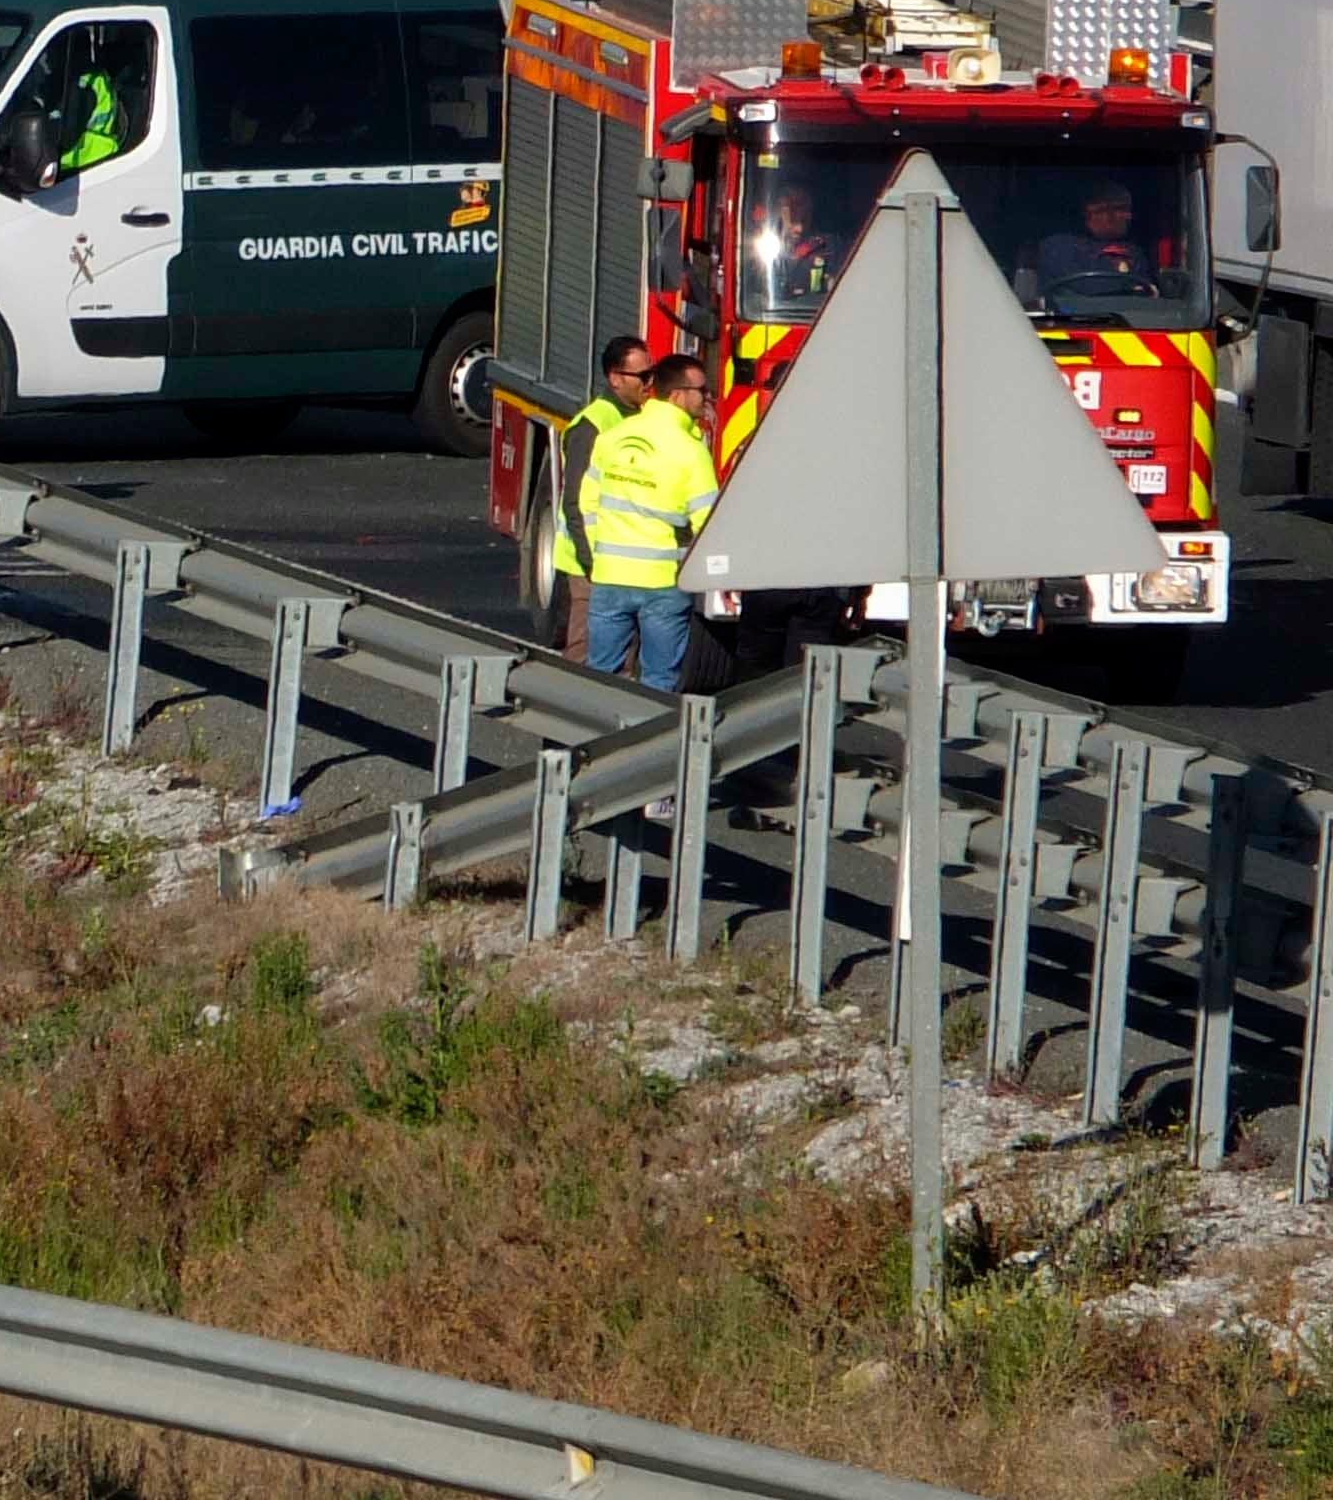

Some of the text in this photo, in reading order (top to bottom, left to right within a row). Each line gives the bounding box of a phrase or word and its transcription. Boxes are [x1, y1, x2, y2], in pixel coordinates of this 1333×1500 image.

[238, 234, 345, 260] GUARDIA
[351, 232, 408, 257] CIVIL
[1141, 471, 1164, 482] 112
